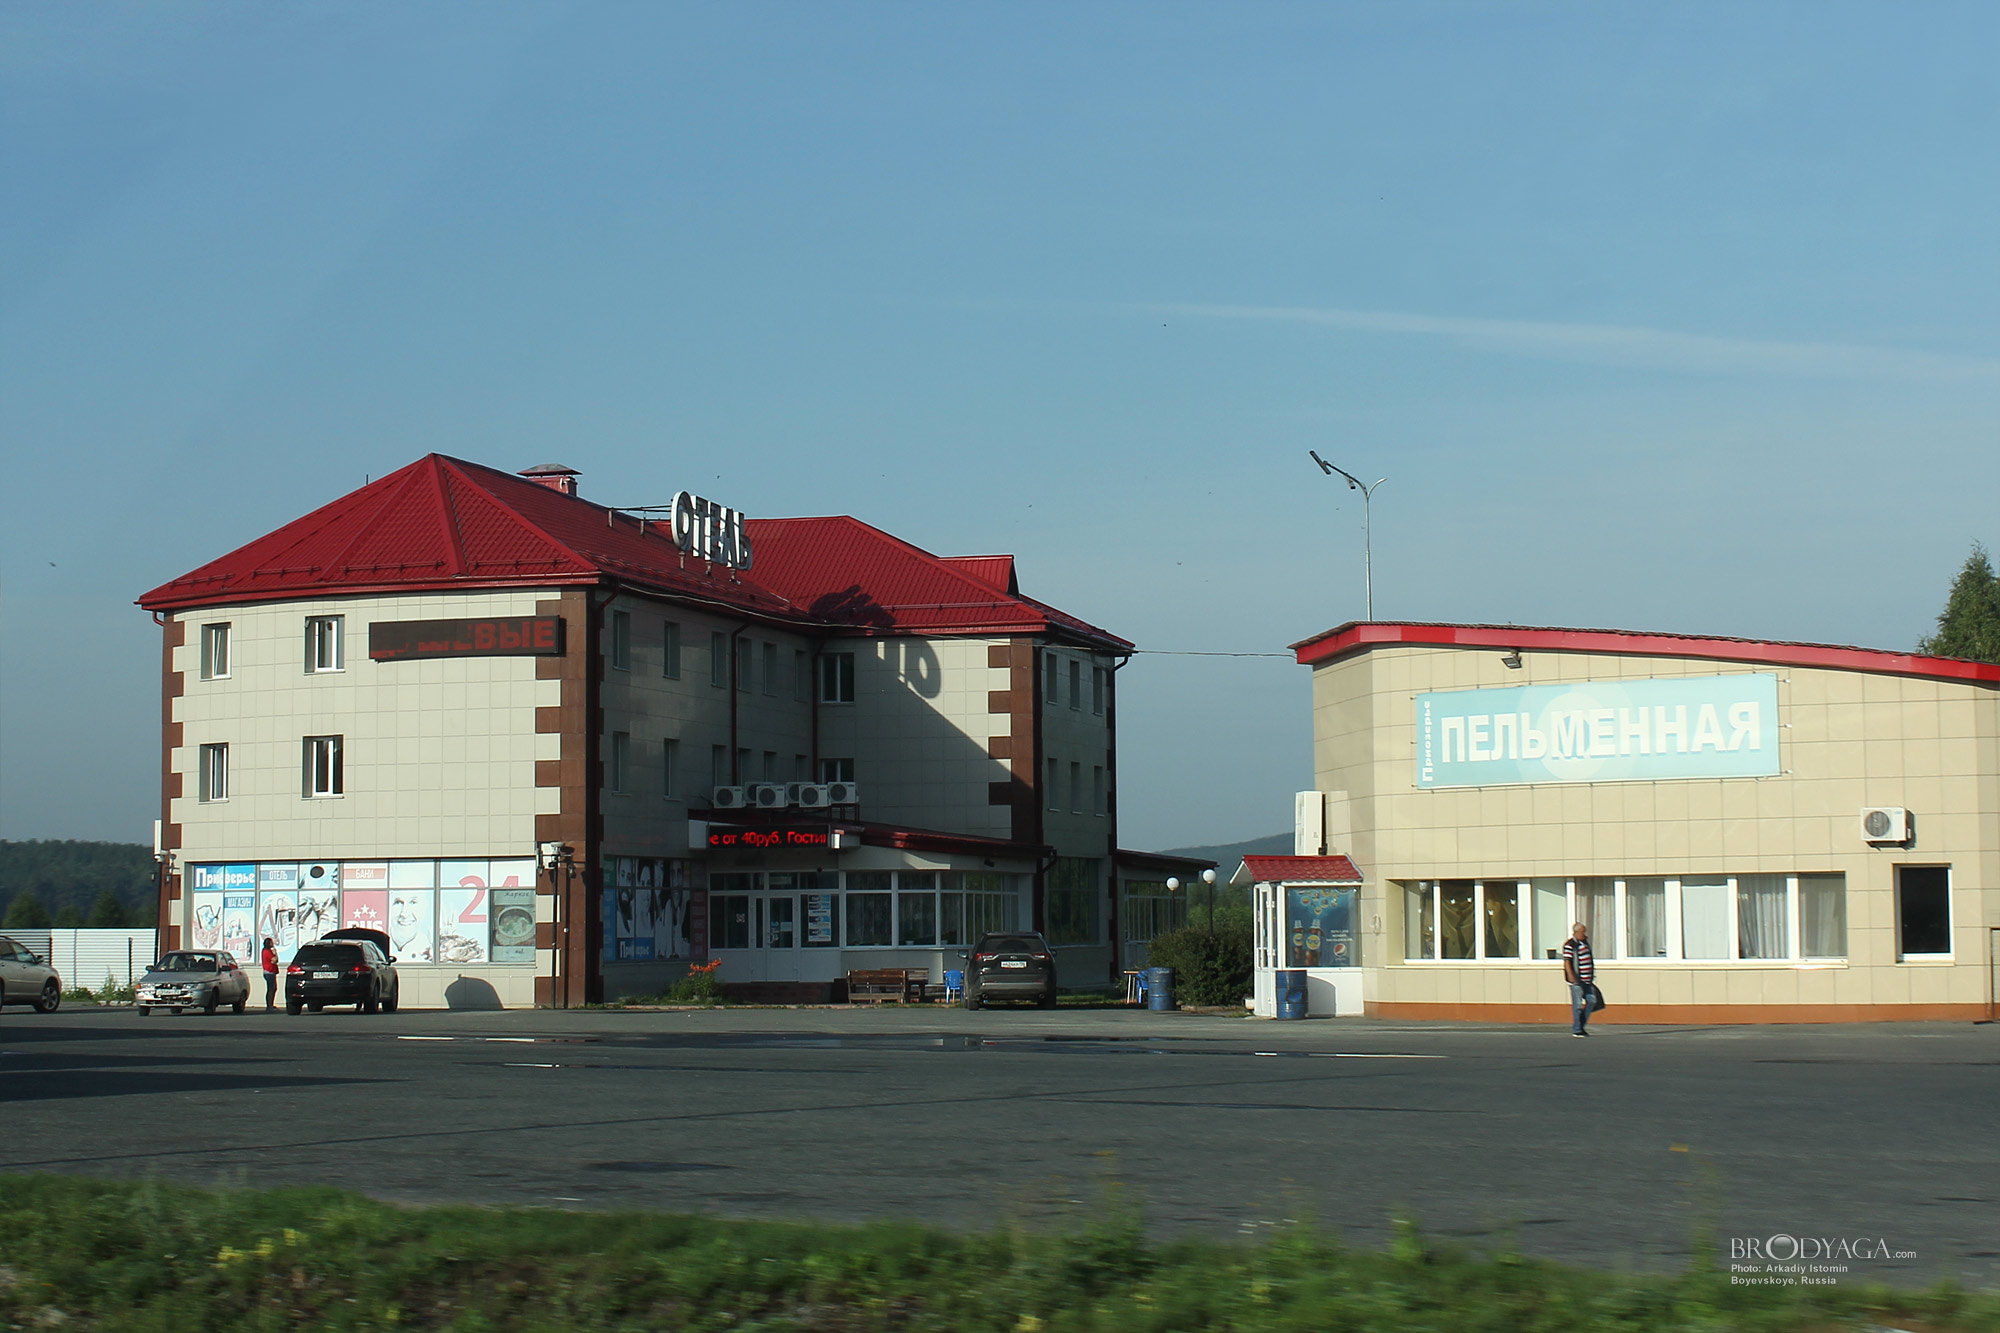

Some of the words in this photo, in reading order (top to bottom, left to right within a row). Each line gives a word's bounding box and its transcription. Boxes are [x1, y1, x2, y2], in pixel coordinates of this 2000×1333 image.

[671, 490, 752, 570] ОТЕЛЬ
[1441, 701, 1761, 763] ПЕЛЬМЕННАЯ
[1422, 701, 1433, 781] Приозерье
[722, 834, 738, 845] от
[269, 870, 287, 880] ОТЕЛЬ
[355, 869, 374, 879] БАНИ
[227, 897, 252, 908] МАГАЗИН
